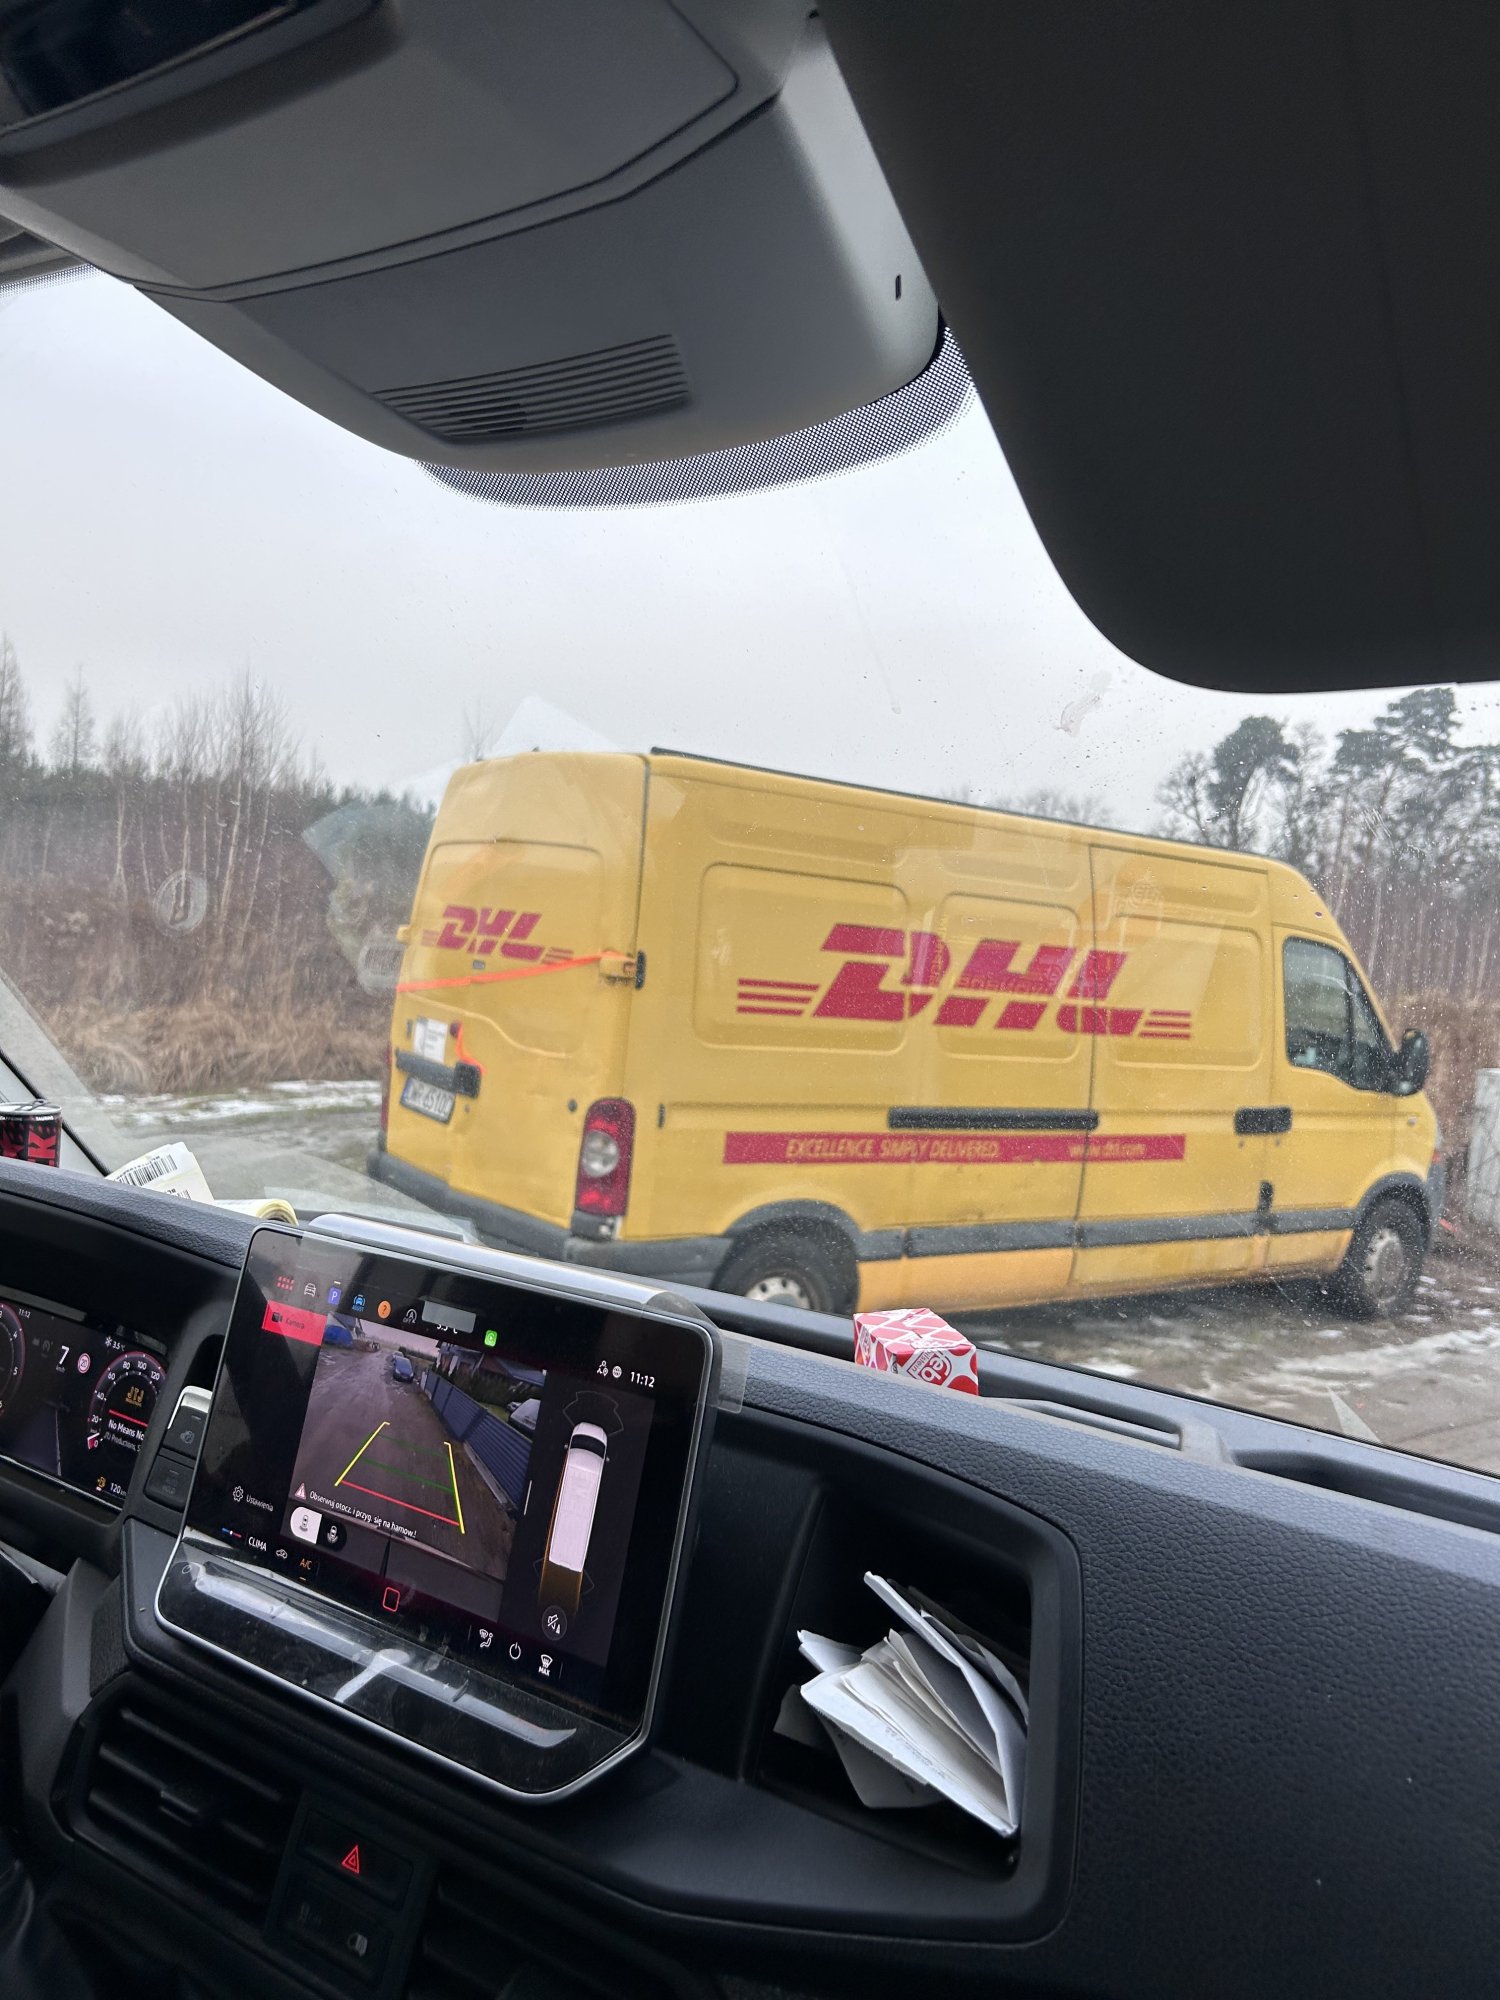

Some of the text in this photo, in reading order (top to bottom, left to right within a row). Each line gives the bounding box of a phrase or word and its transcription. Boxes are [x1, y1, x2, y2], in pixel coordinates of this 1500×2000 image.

[436, 905, 546, 962] DHL
[812, 923, 1144, 1036] DHL
[785, 1138, 1000, 1159] EXCELLENCE SIMPLY DELIVERED
[18, 1308, 31, 1318] 11:12
[13, 1330, 18, 1339] 4
[59, 1345, 70, 1365] 7
[13, 1366, 19, 1376] 5
[122, 1360, 131, 1370] 80
[137, 1360, 147, 1370] 100
[107, 1371, 116, 1381] 60
[150, 1370, 161, 1381] 120
[630, 1371, 655, 1388] 11:12
[96, 1391, 105, 1401] 40
[91, 1414, 99, 1424] 20
[108, 1418, 117, 1430] No
[117, 1422, 136, 1437] Means
[110, 1482, 121, 1494] 120
[246, 1494, 274, 1512] Ustawienia
[309, 1490, 335, 1509] Obserwuj
[335, 1501, 352, 1514] otocz.
[355, 1510, 373, 1523] przyg.
[382, 1519, 391, 1529] na
[248, 1536, 267, 1552] CLIMA
[299, 1558, 313, 1570] A/C
[538, 1665, 551, 1677] MAX
